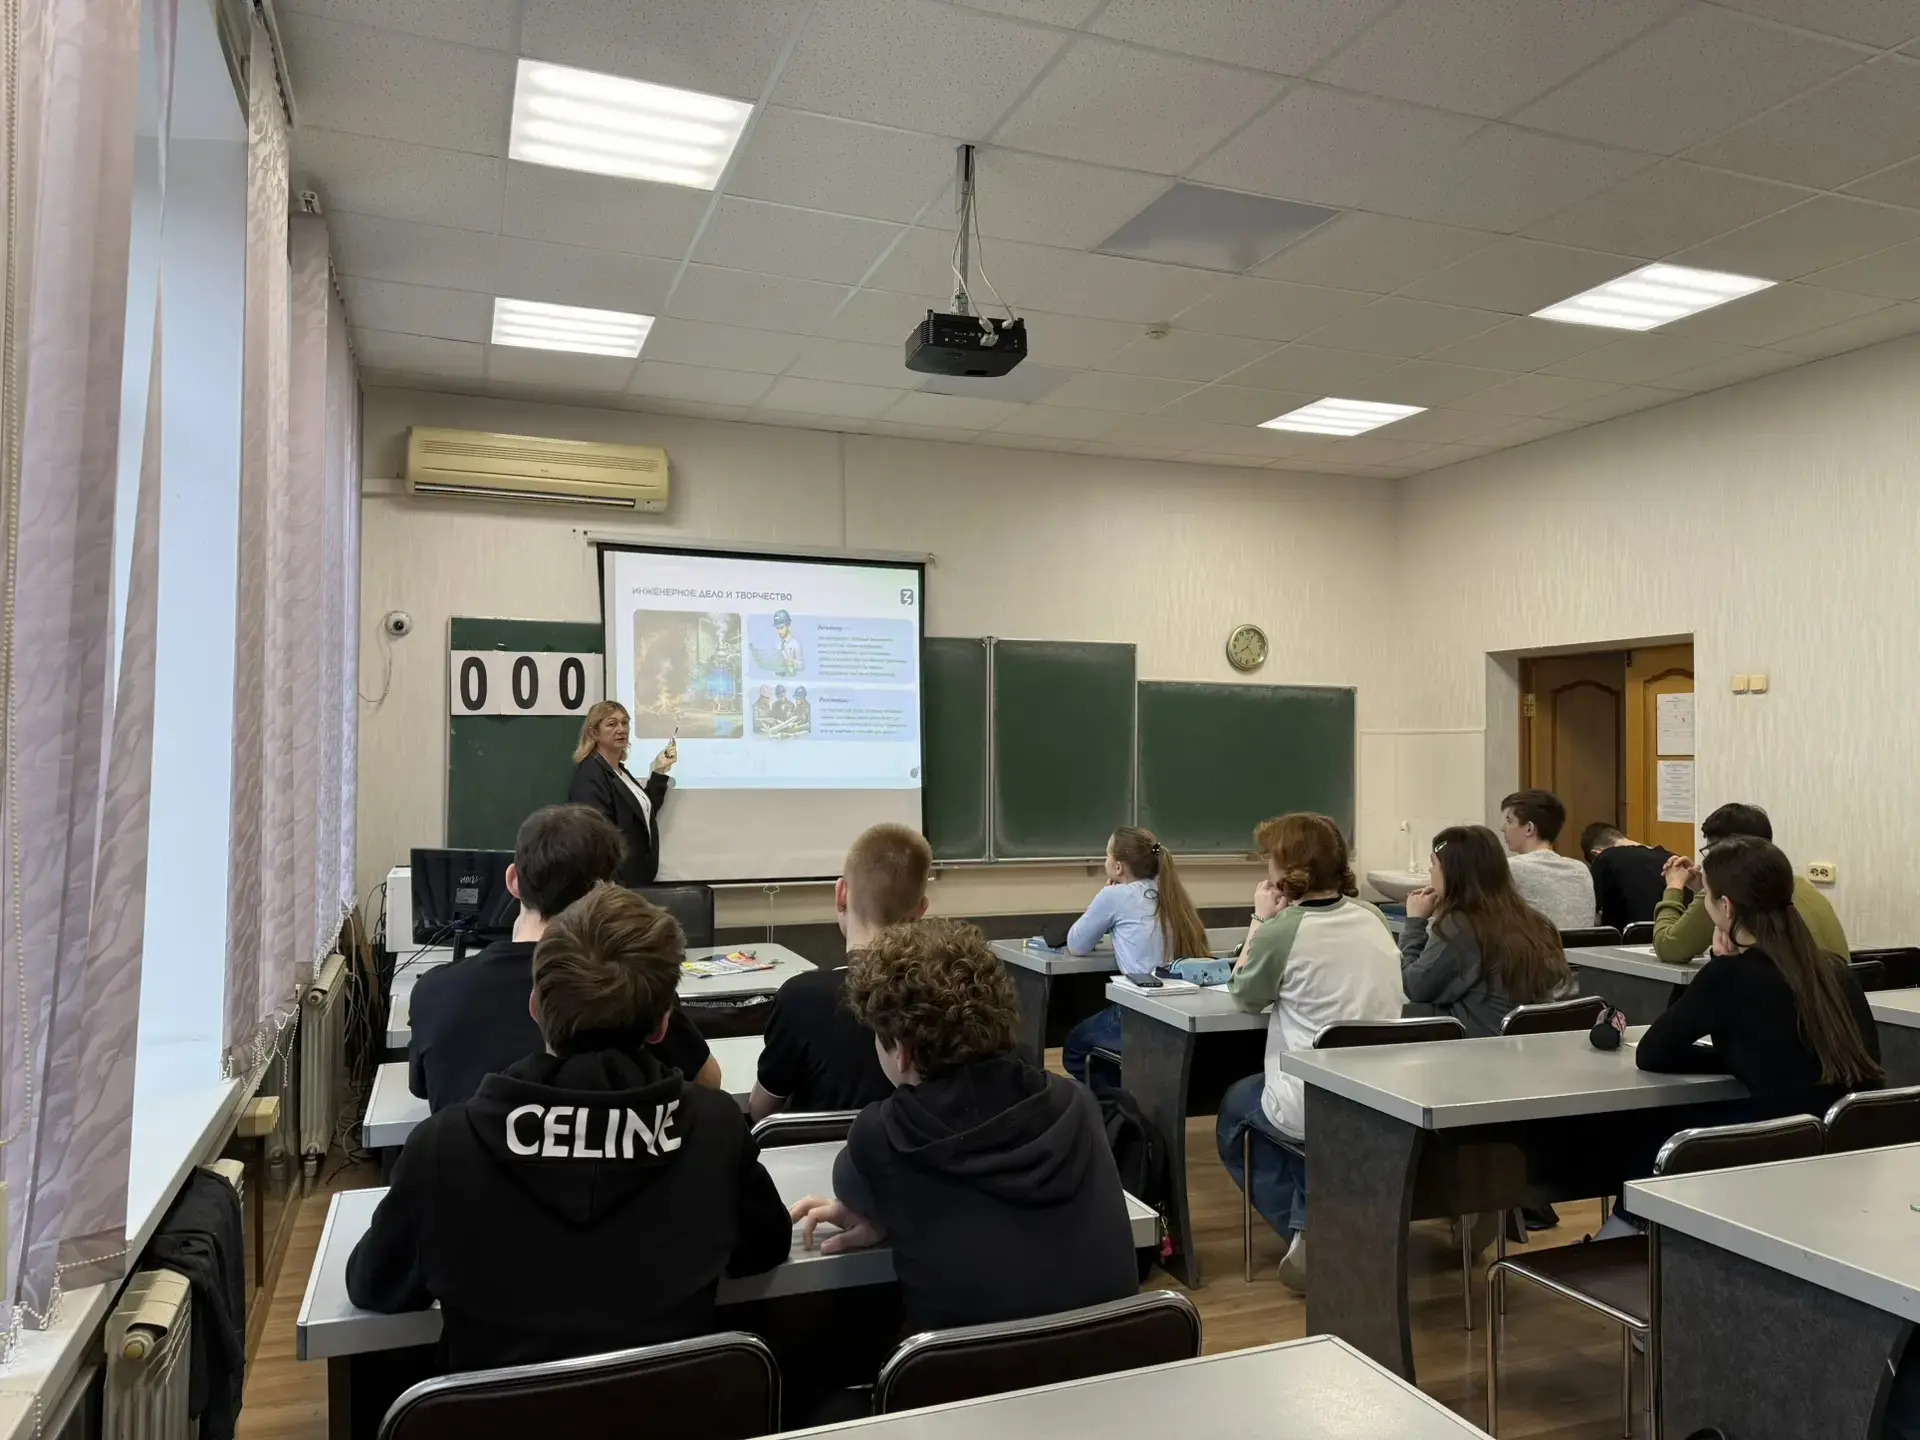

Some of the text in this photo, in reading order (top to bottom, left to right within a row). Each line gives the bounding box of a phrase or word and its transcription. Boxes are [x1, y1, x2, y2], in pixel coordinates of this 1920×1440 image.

[632, 586, 793, 601] ИНЖЕНЕРНОЕ ДЕЛО И ТВОРЧЕСТВО
[506, 1099, 682, 1159] CELINE
